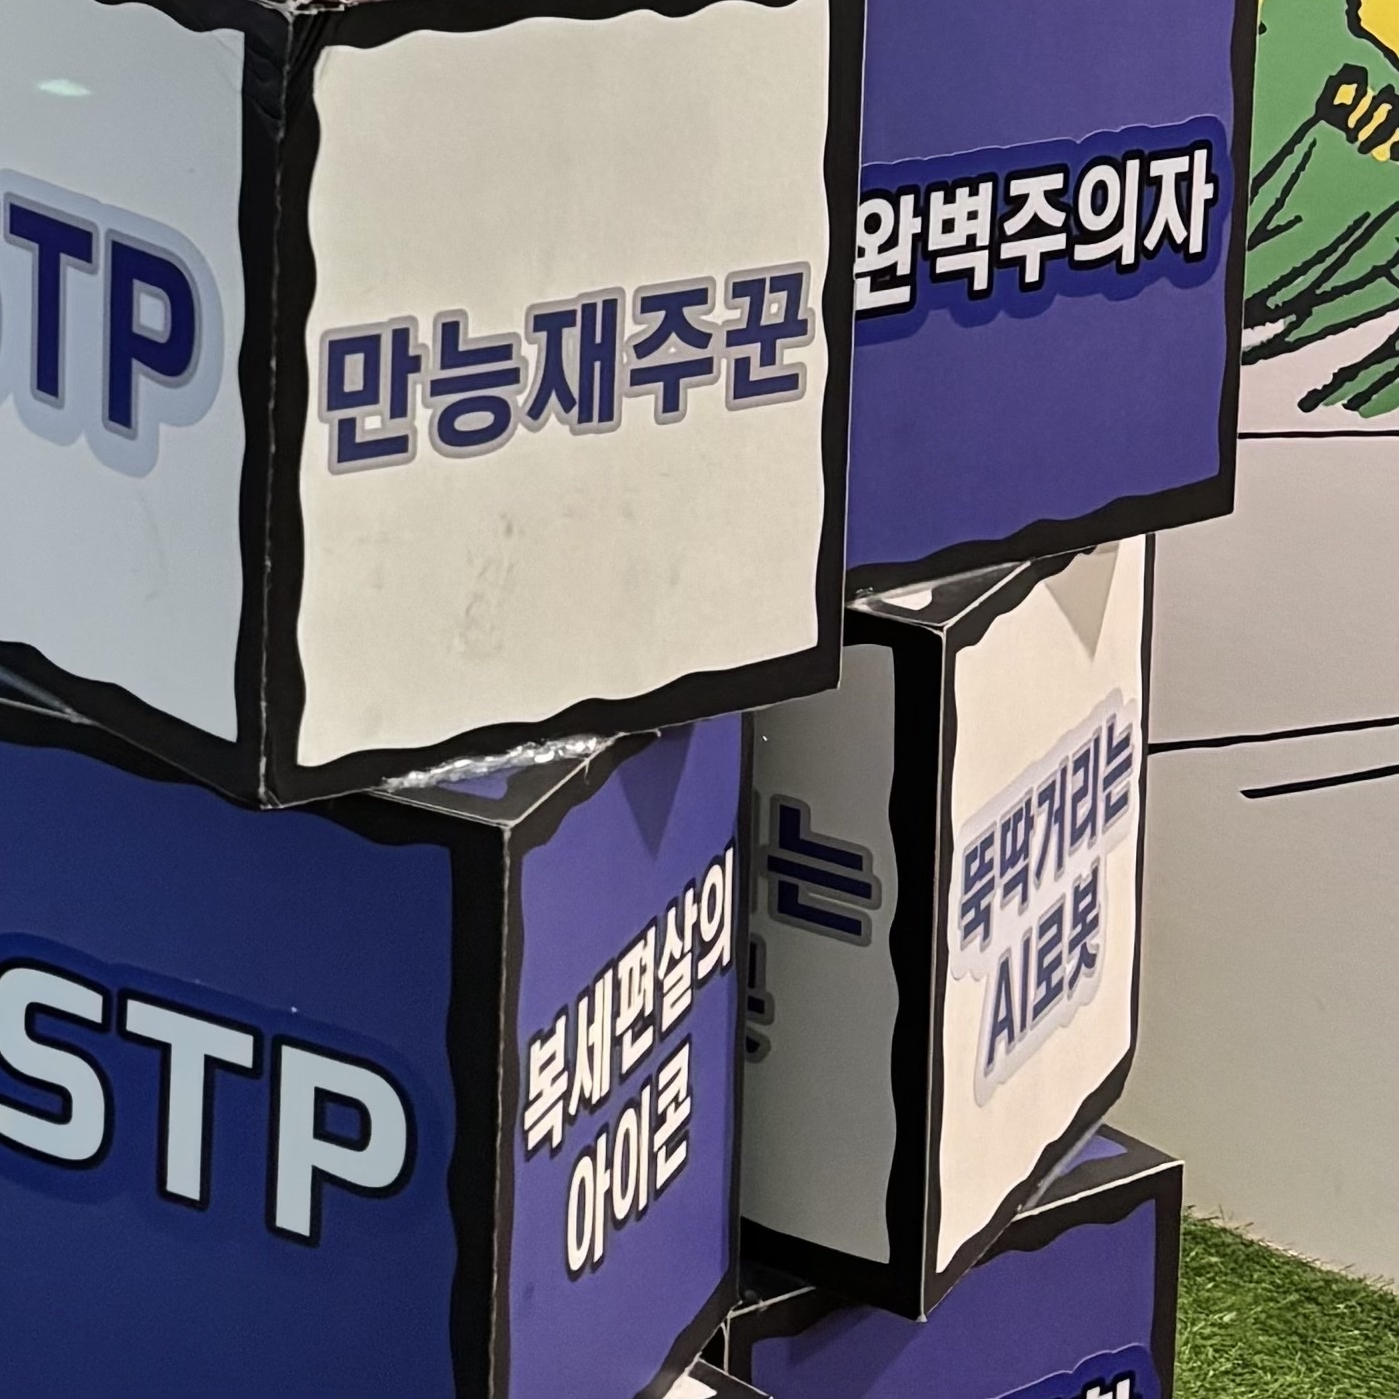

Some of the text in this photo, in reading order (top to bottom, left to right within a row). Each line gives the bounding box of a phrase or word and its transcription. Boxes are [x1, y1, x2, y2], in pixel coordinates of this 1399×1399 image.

[854, 146, 1215, 312] 완벽주의자
[323, 269, 810, 465] 만능재주꾼
[960, 712, 1133, 953] 뚝딱거리는
[523, 844, 736, 1153] 복세편살의
[983, 857, 1101, 1077] AI로봇
[566, 1041, 691, 1274] 아이콘
